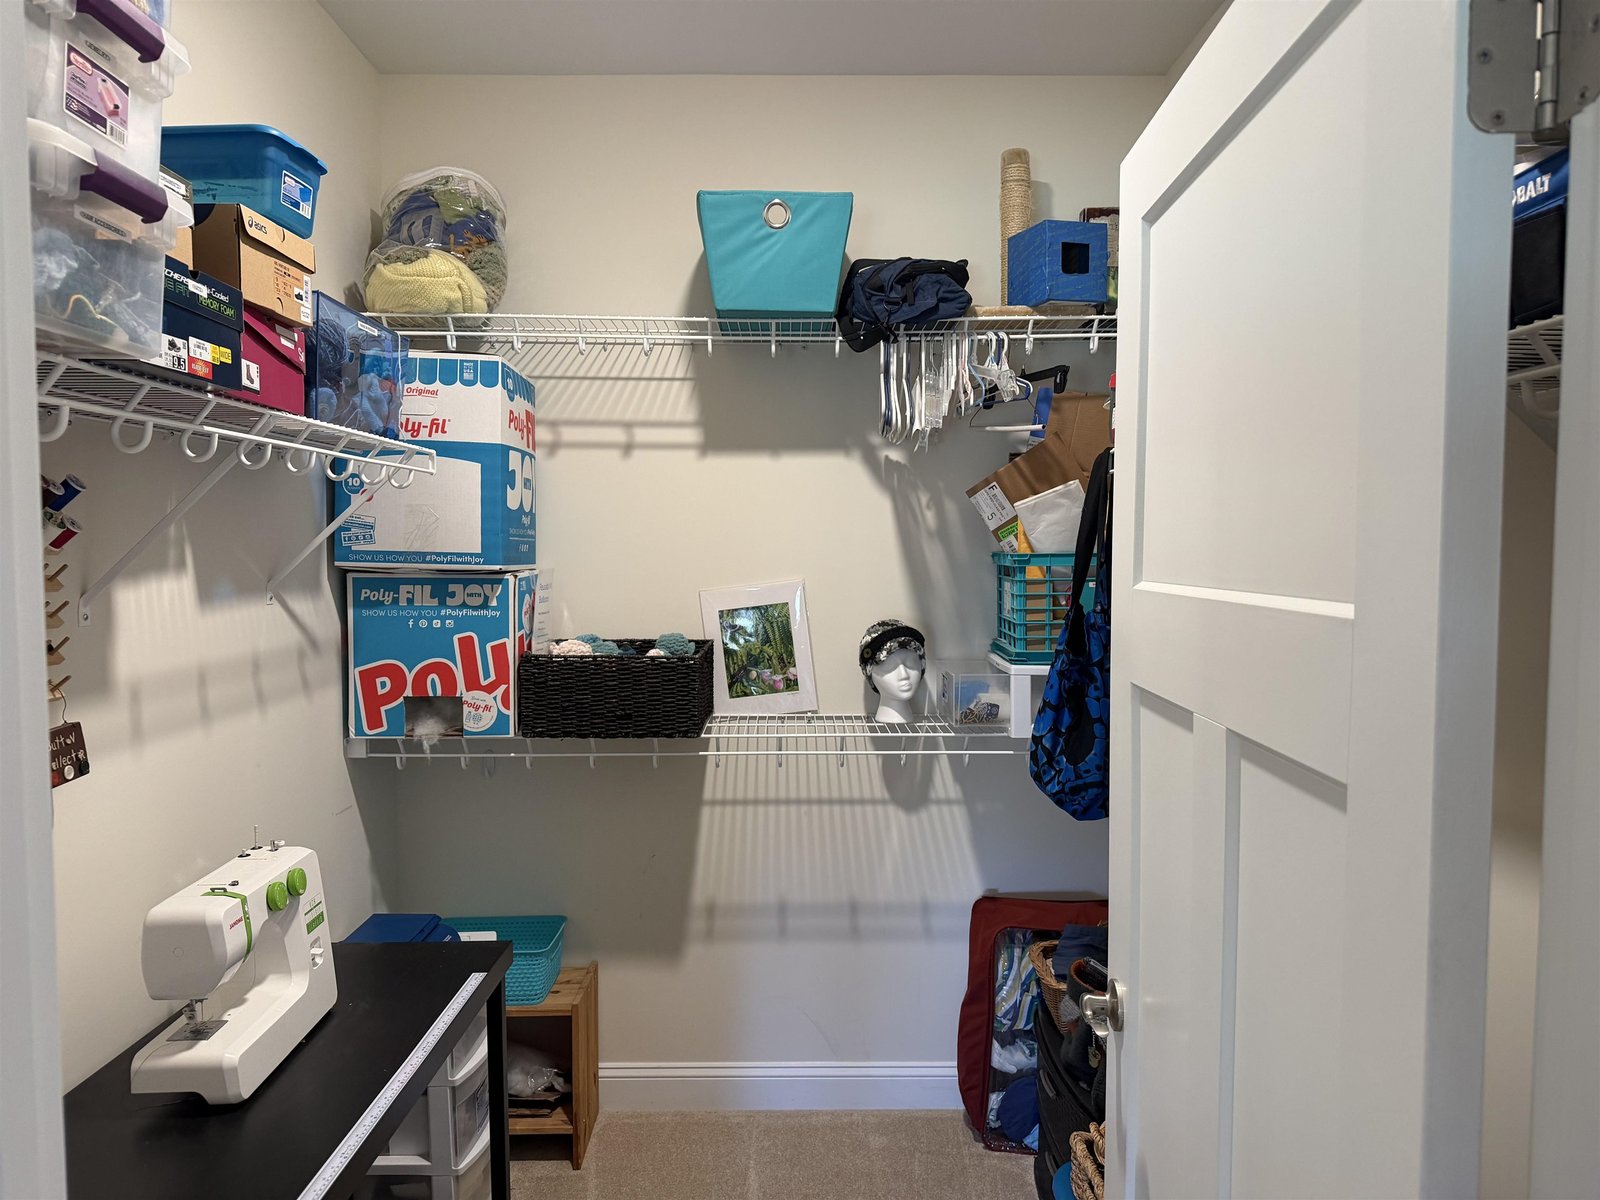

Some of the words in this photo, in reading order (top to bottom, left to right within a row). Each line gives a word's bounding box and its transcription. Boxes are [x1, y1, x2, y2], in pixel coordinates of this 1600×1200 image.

[254, 220, 267, 234] asics
[220, 305, 235, 318] FOAM
[173, 356, 185, 370] 9.5
[406, 386, 439, 397] Original
[346, 477, 360, 486] 10
[349, 553, 373, 562] SHOW
[373, 554, 385, 562] US
[386, 554, 404, 563] HOW
[405, 555, 423, 563] YOU
[425, 555, 484, 565] #PolyFilwithJoy
[360, 583, 439, 607] Poly-FIL
[445, 583, 502, 607] JOY
[361, 608, 386, 617] SHOW
[387, 609, 398, 617] US
[399, 609, 419, 617] HOW
[420, 609, 438, 617] YOU
[440, 608, 501, 619] #PolyFilwithJoy
